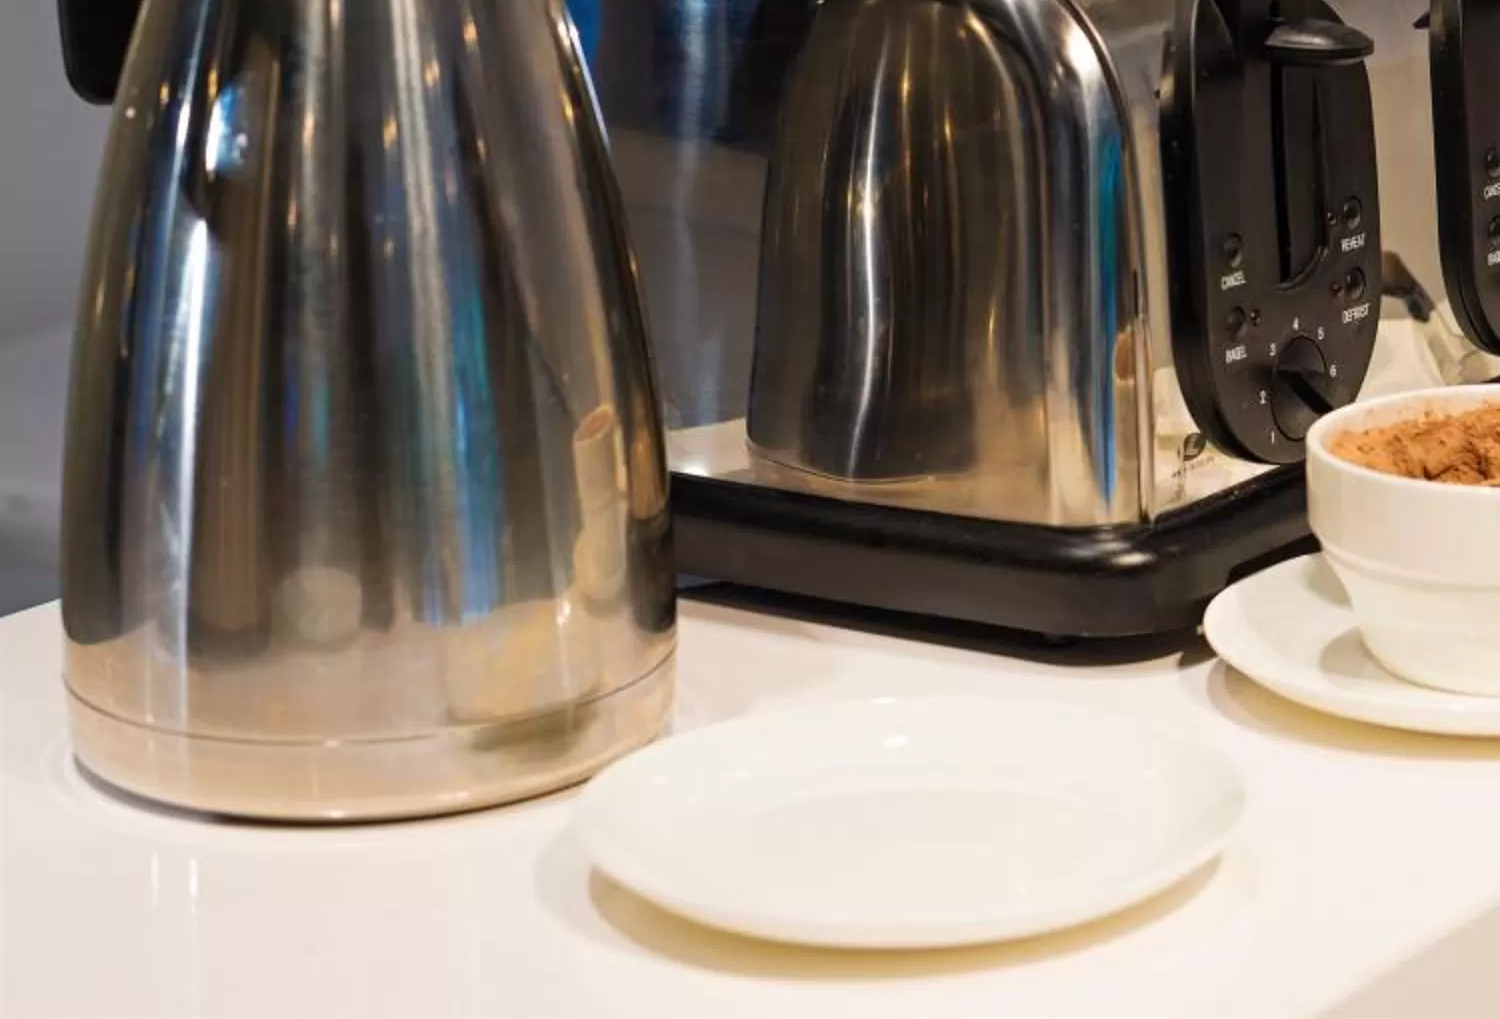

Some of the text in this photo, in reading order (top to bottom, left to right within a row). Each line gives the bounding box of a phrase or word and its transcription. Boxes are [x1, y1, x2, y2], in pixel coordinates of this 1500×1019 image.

[1292, 316, 1299, 331] 4
[1317, 326, 1325, 340] 5
[1269, 342, 1277, 357] 3
[1329, 364, 1337, 378] 6
[1259, 389, 1266, 404] 2
